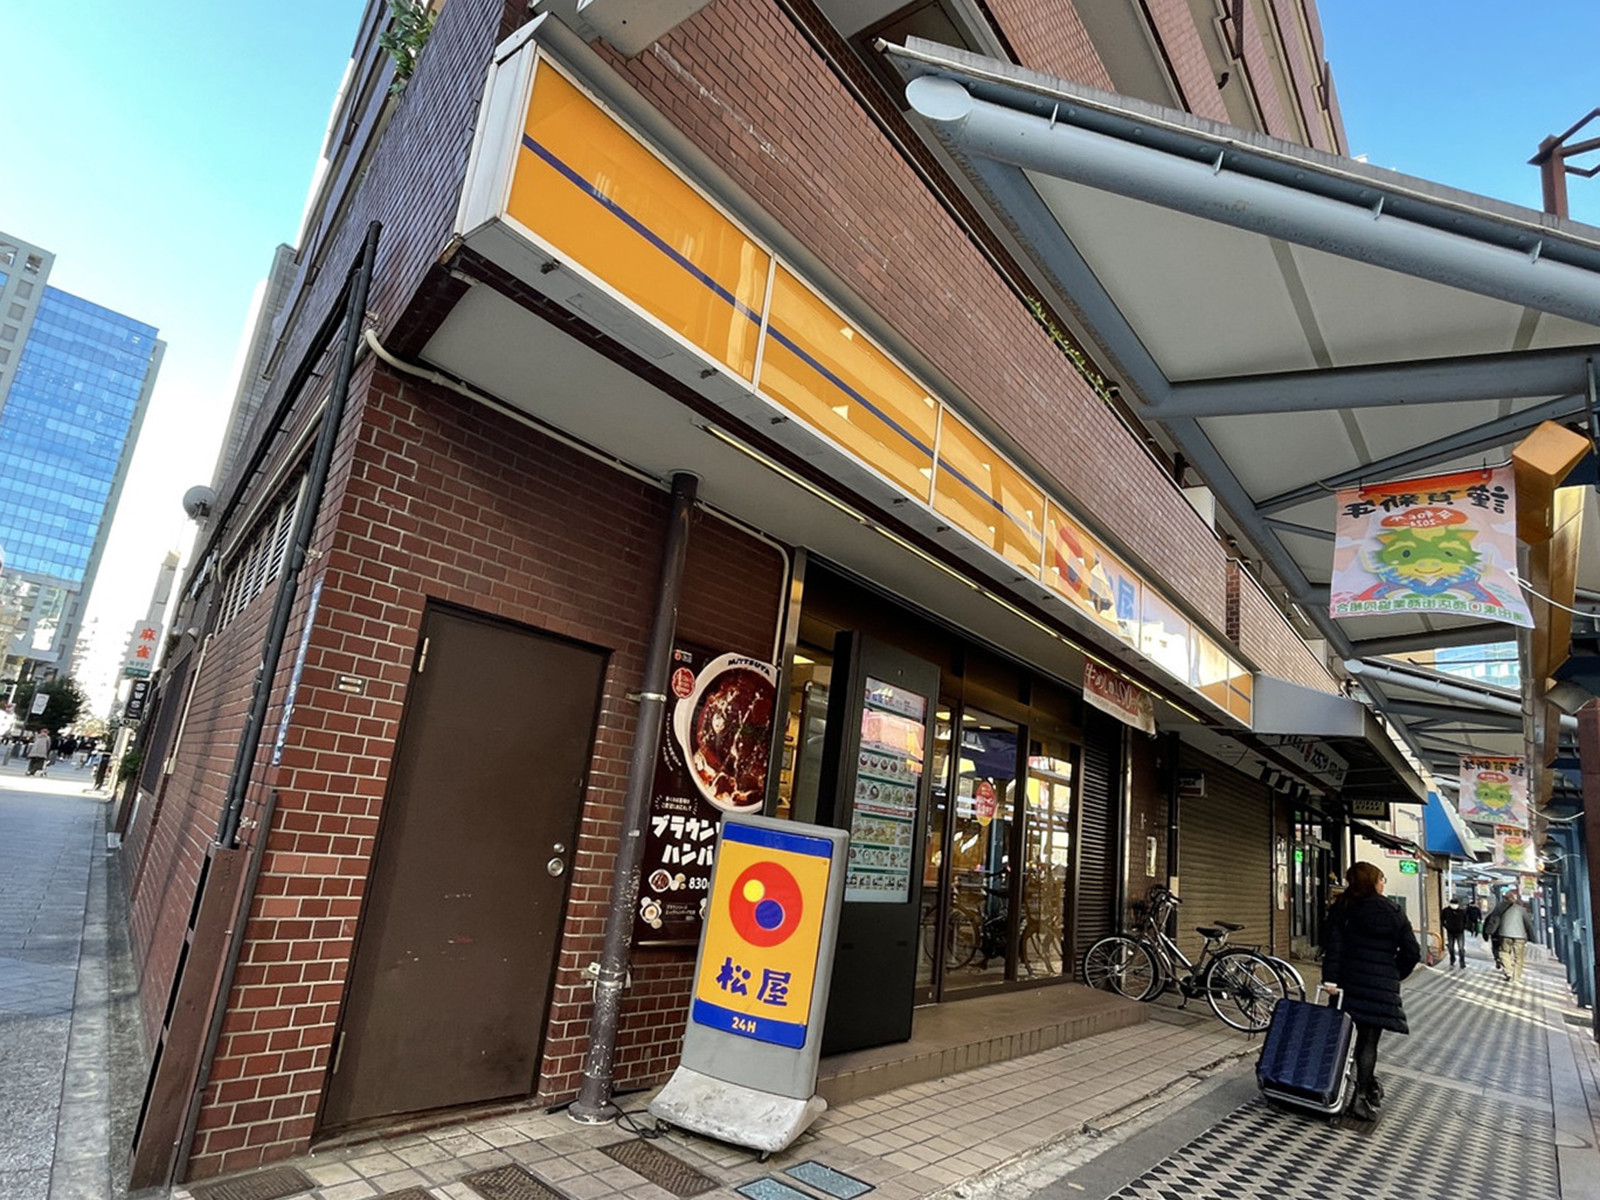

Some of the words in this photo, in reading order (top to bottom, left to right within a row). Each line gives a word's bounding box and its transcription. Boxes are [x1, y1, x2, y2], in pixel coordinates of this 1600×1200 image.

[136, 627, 157, 659] 麻雀
[652, 814, 721, 841] ブラウン
[688, 876, 711, 890] 830
[716, 956, 791, 1006] 松屋
[731, 1016, 757, 1033] 24H
